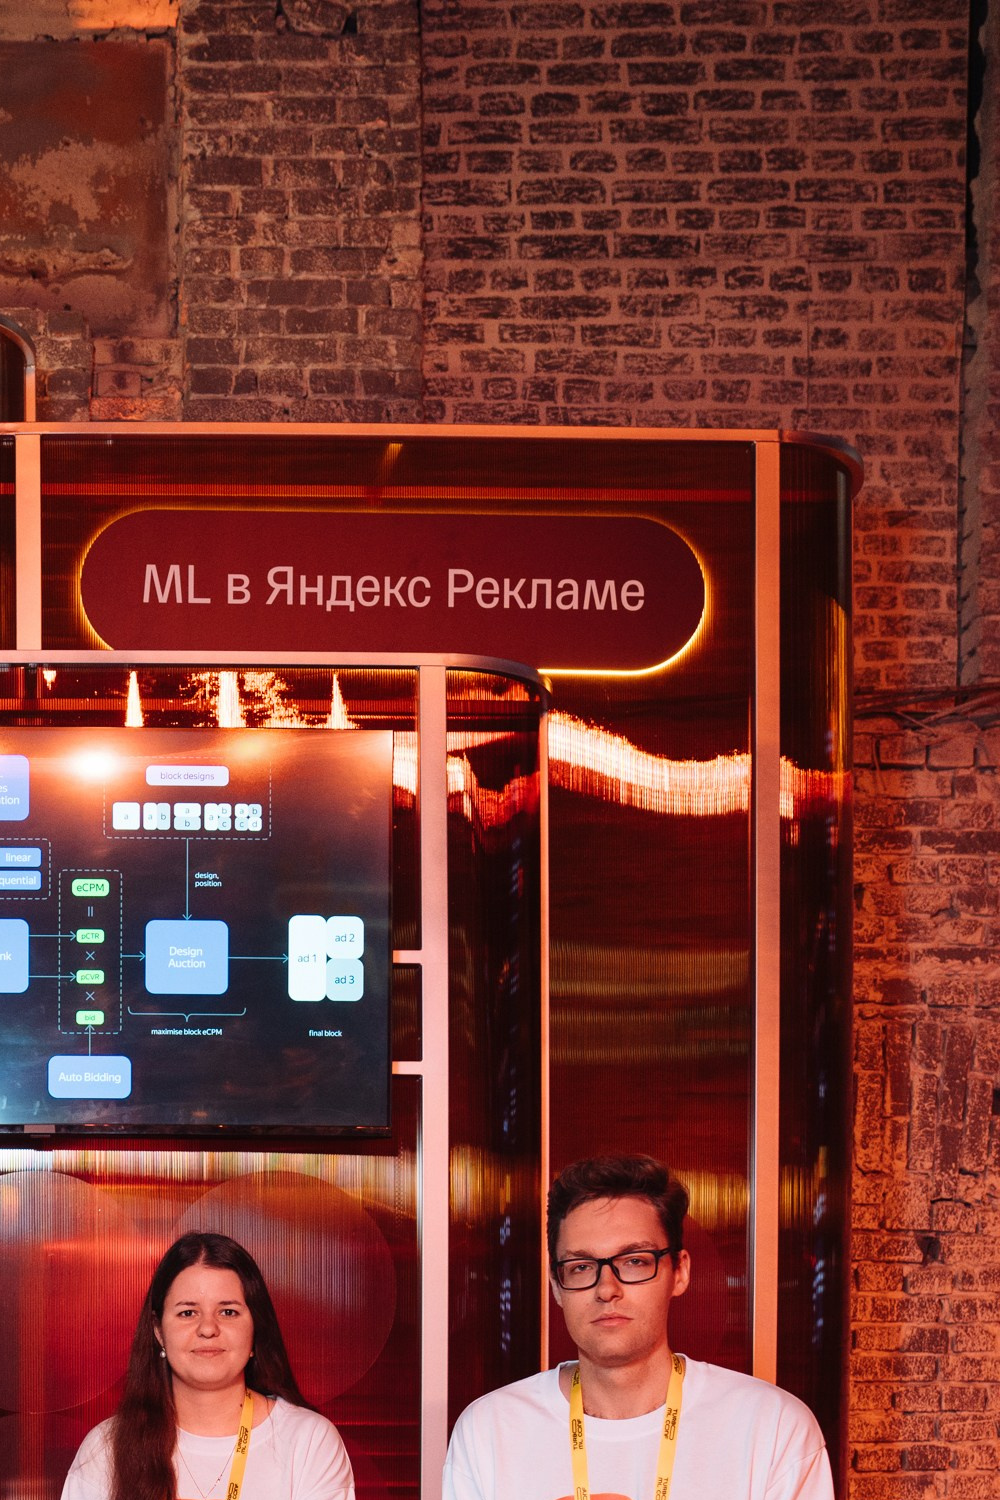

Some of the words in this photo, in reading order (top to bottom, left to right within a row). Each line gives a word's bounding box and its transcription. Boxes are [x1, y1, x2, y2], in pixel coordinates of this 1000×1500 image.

[142, 564, 211, 605] ML
[226, 575, 250, 605] в
[266, 566, 431, 612] Яндекс
[448, 568, 645, 611] Рекламе
[160, 772, 182, 780] block
[183, 772, 215, 782] designs
[5, 852, 31, 862] linear
[194, 872, 219, 880] design,
[76, 883, 105, 892] eCPM
[194, 880, 222, 888] position
[81, 933, 100, 941] pCTR
[334, 934, 347, 943] ad
[349, 934, 355, 942] 2
[169, 946, 203, 958] Design
[297, 954, 310, 963] ad
[168, 959, 206, 969] Auction
[334, 975, 347, 985] ad
[349, 975, 355, 984] 3
[84, 1014, 96, 1022] bid
[151, 1028, 183, 1036] maximise
[183, 1028, 202, 1036] block
[58, 1072, 83, 1082] Auto
[84, 1072, 122, 1084] Bidding
